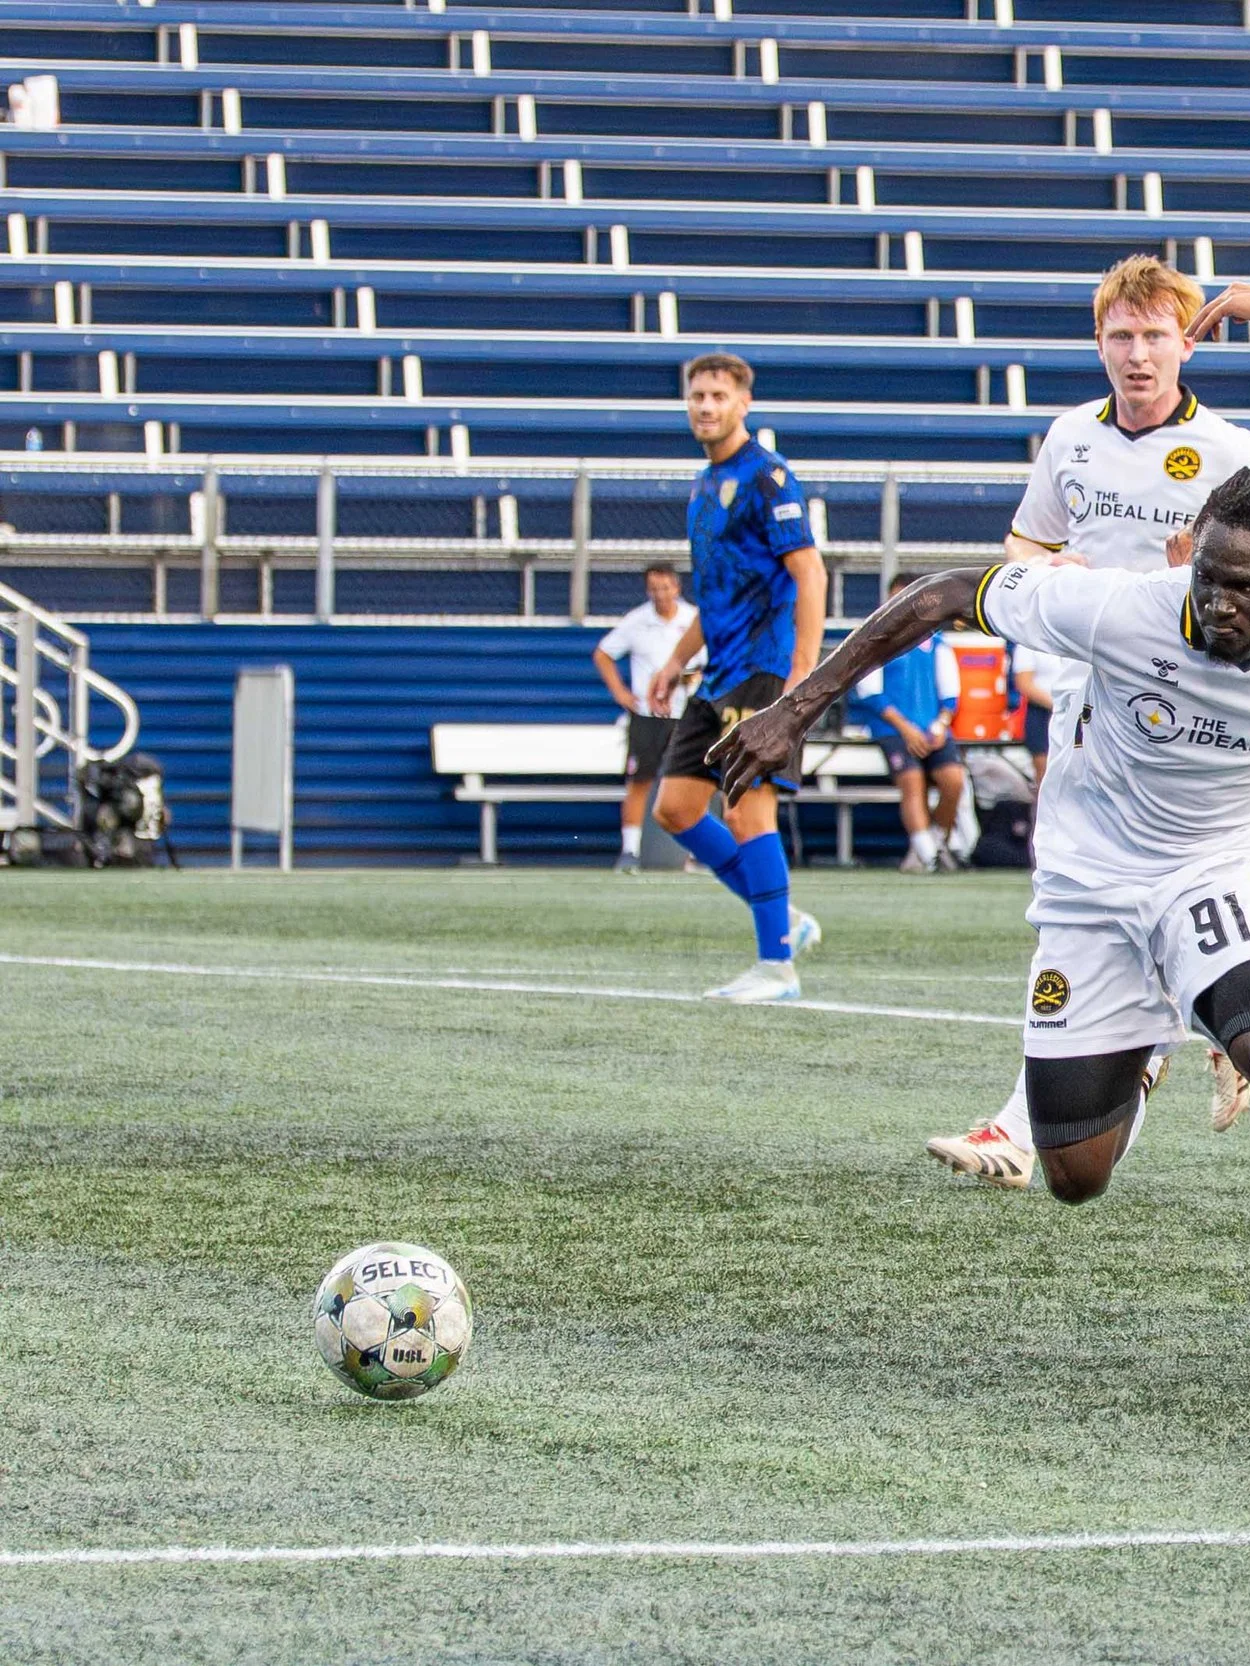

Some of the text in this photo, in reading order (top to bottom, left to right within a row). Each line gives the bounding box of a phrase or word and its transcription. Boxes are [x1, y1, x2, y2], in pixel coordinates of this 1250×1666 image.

[1095, 490, 1120, 502] THE
[1095, 503, 1147, 521] IDEAL
[1192, 715, 1228, 734] THE
[1029, 1018, 1068, 1029] hummel
[362, 1260, 448, 1284] SELECT
[392, 1348, 427, 1364] USL
